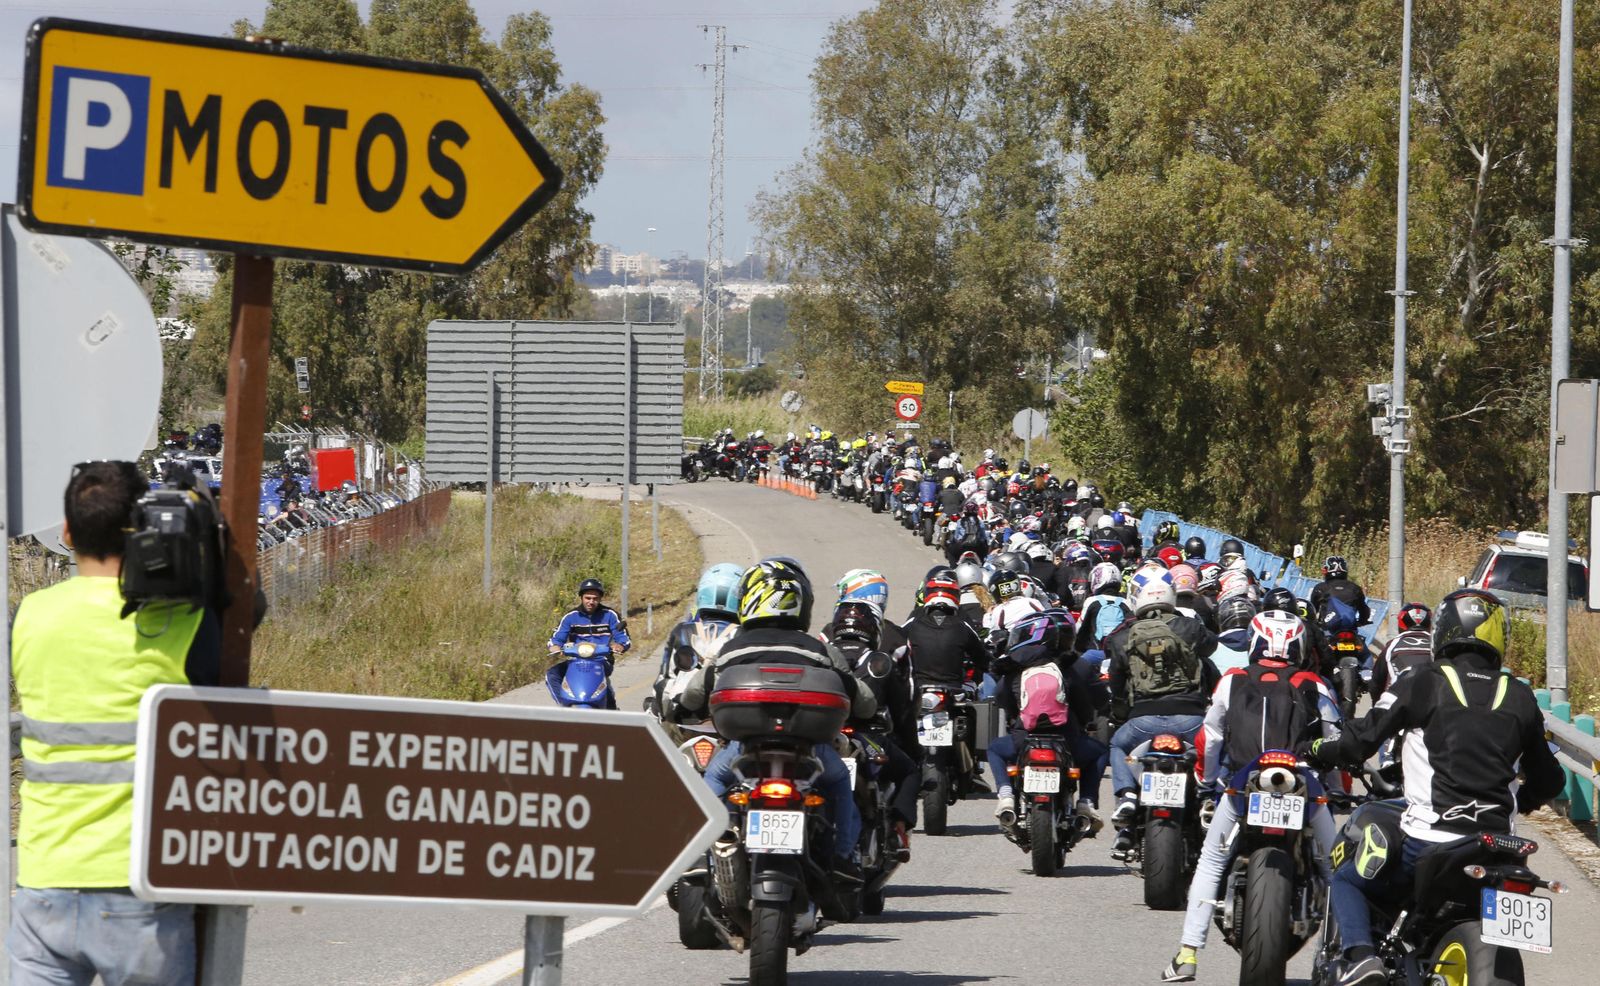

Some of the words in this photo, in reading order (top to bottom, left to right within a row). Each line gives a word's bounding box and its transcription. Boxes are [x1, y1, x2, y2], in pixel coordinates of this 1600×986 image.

[62, 77, 133, 181] P
[158, 89, 471, 220] MOTOS
[902, 403, 915, 411] 50
[168, 721, 328, 764] CENTRO
[348, 730, 624, 781] EXPERIMENTAL
[1027, 779, 1057, 791] 7710
[1153, 775, 1181, 788] 1564
[1155, 788, 1178, 801] GWZ
[165, 775, 363, 820] AGRICOLA
[385, 785, 591, 831] GANADERO
[1262, 796, 1301, 812] 9996
[762, 813, 800, 829] 8657
[1261, 810, 1290, 826] DHW
[761, 831, 789, 846] DLZ
[160, 828, 398, 874] DIPUTACION
[417, 839, 466, 877] DE
[486, 842, 595, 882] CADIZ
[1486, 907, 1493, 915] E
[1501, 896, 1546, 921] 9013
[1500, 918, 1534, 939] JPC
